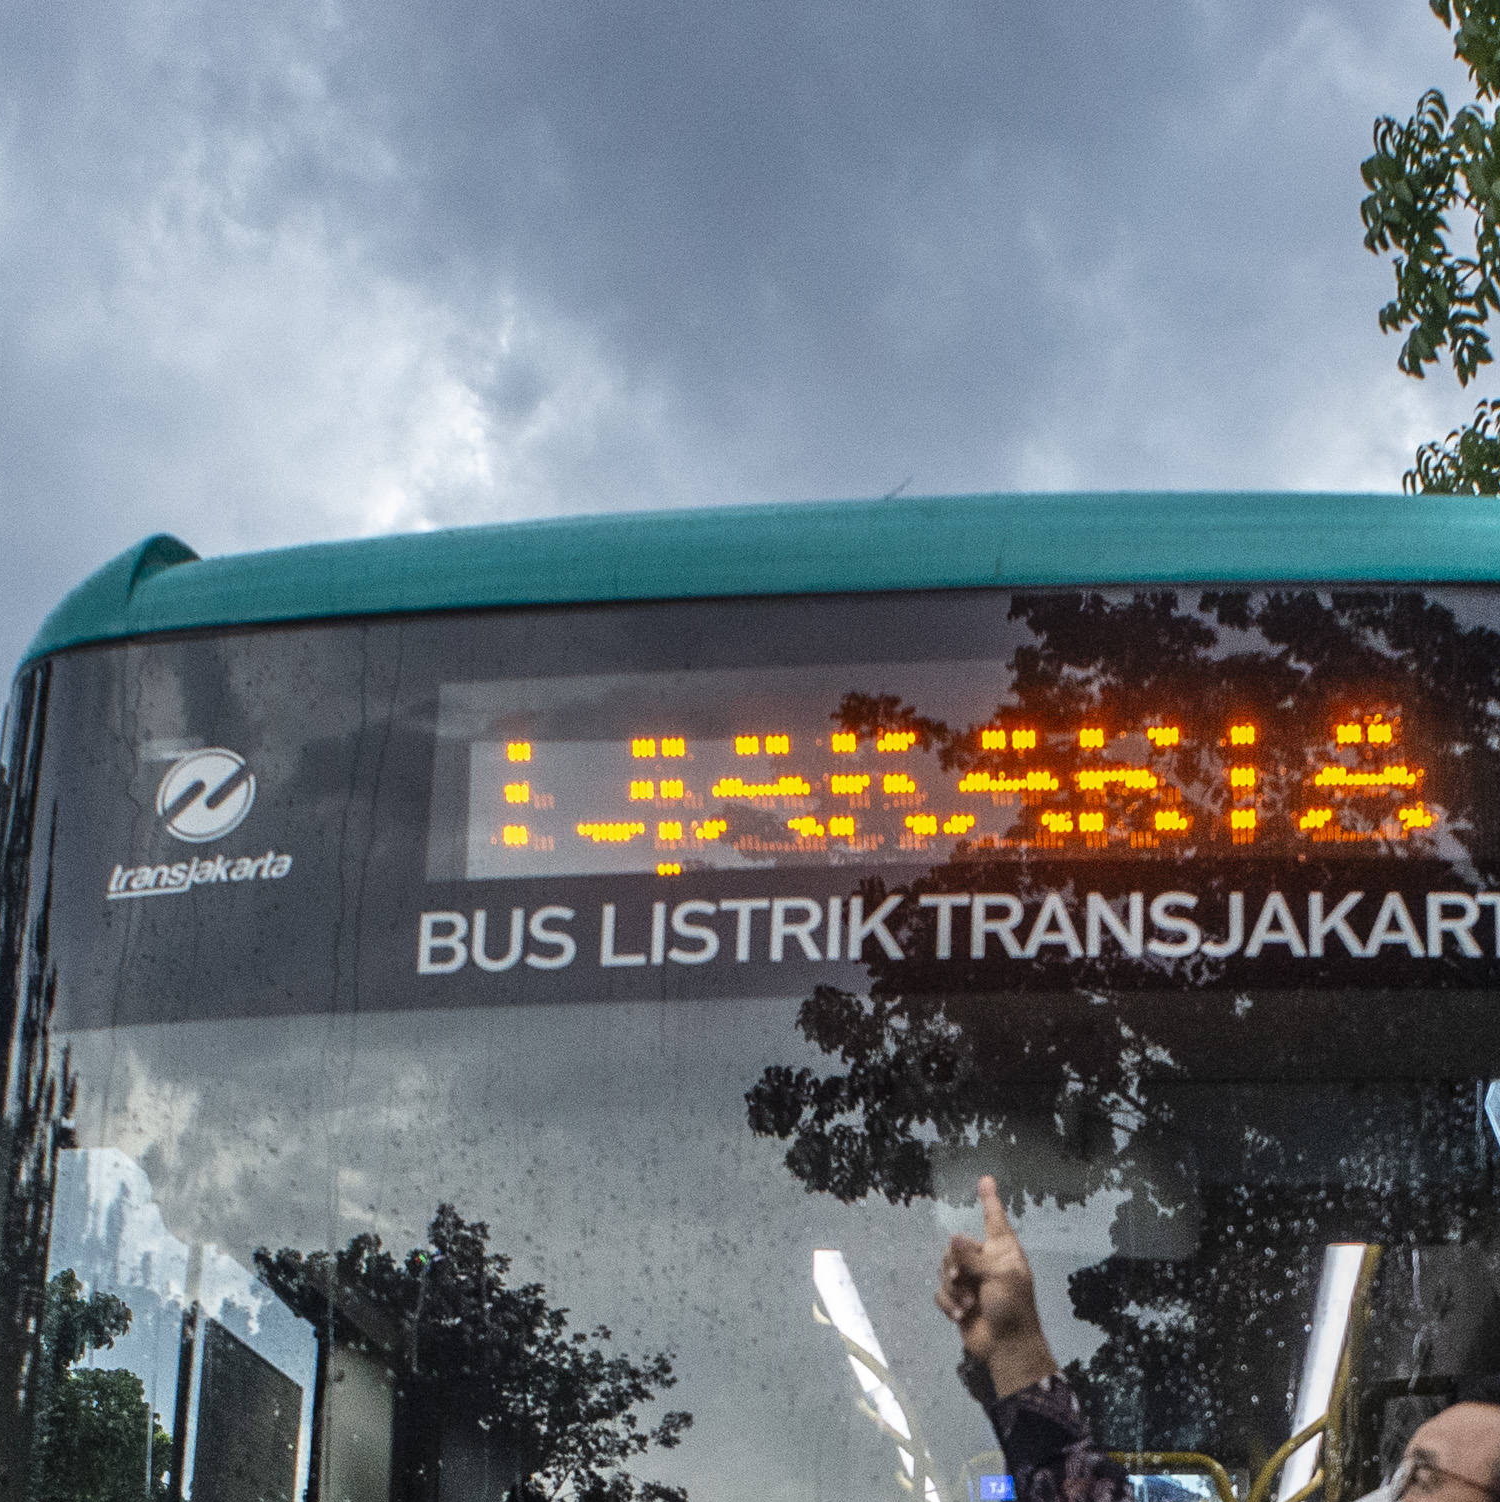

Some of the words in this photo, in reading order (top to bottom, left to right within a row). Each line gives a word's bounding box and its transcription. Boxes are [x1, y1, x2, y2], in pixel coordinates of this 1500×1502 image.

[106, 850, 293, 900] transjakarta
[416, 905, 578, 975] BUS
[600, 893, 907, 967] LISTRIK
